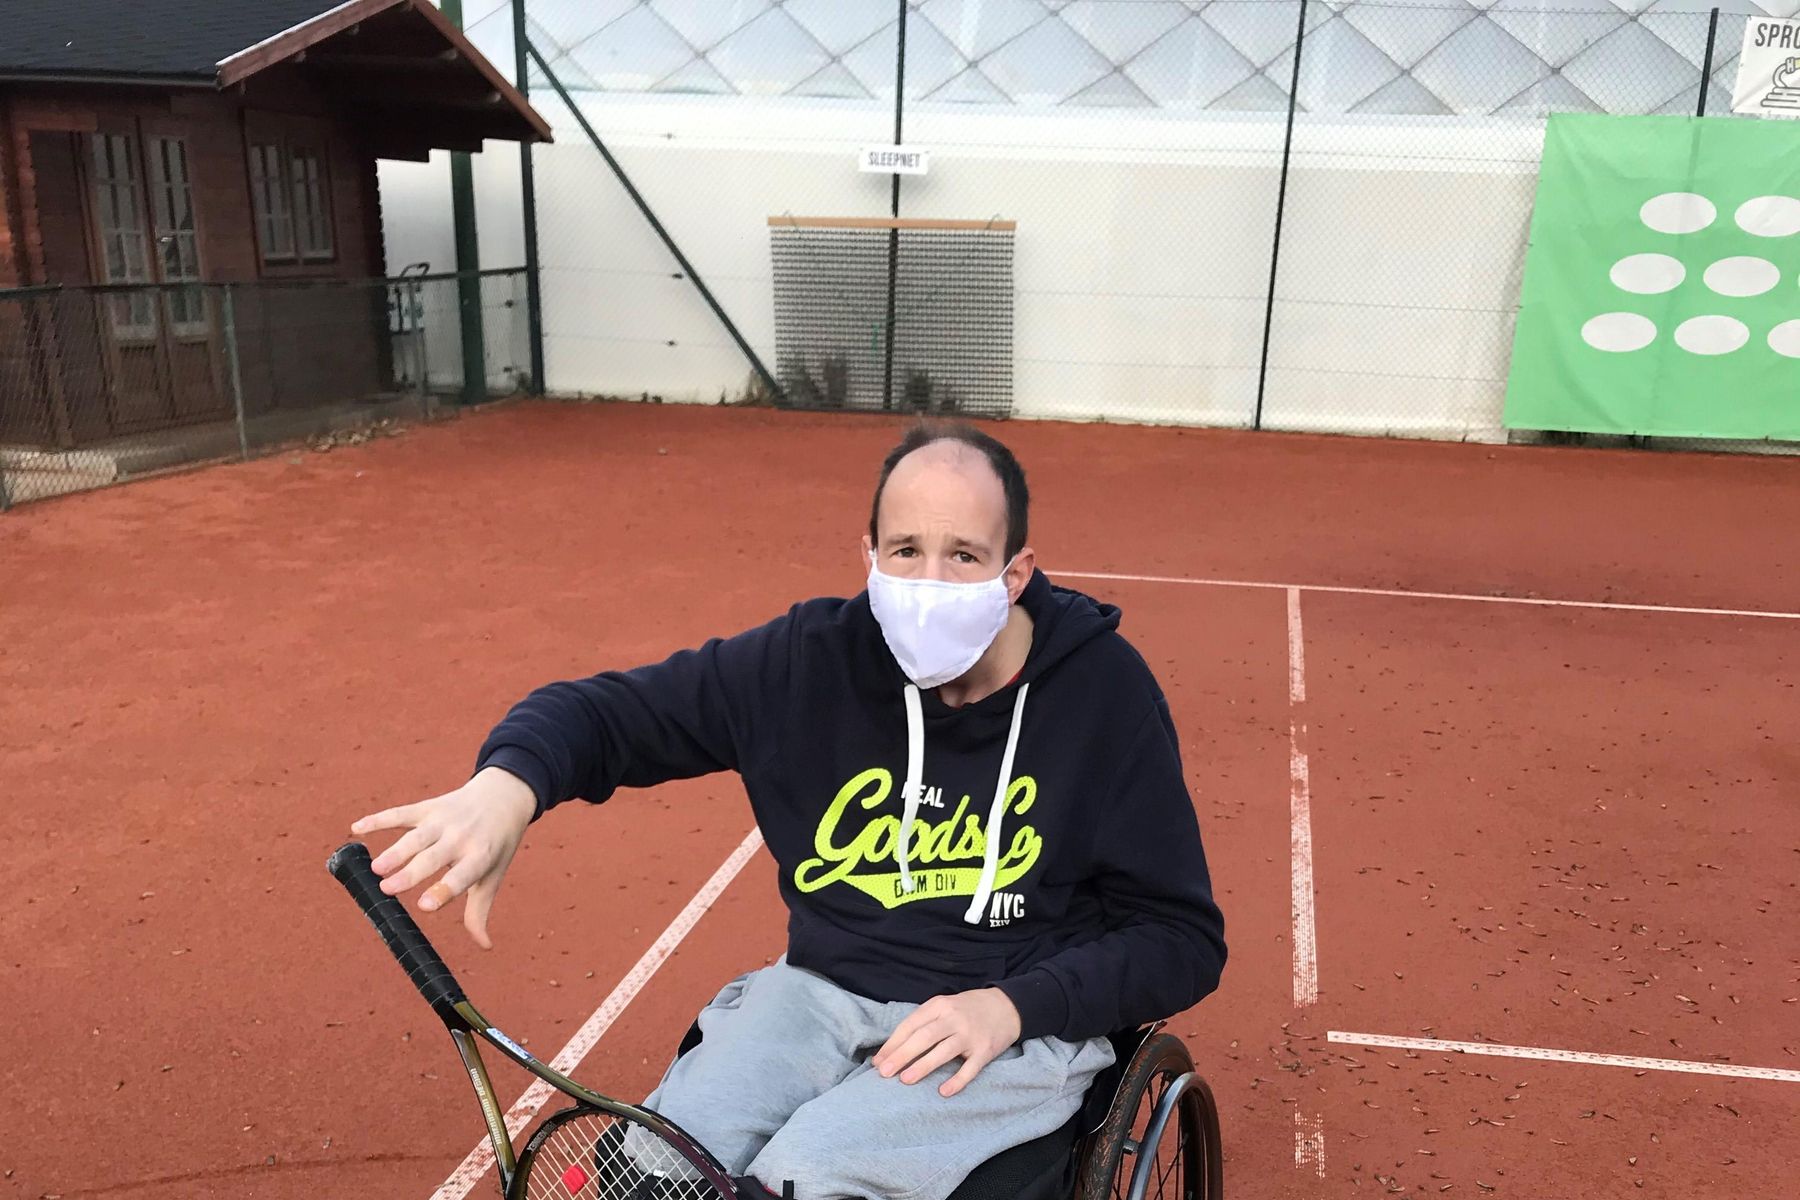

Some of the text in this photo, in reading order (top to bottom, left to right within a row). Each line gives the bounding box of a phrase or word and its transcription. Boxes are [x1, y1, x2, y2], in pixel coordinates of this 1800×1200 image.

[868, 151, 921, 168] SLEEPNET
[901, 781, 945, 808] EAL
[894, 873, 956, 898] DM DIV
[989, 891, 1025, 919] NYC
